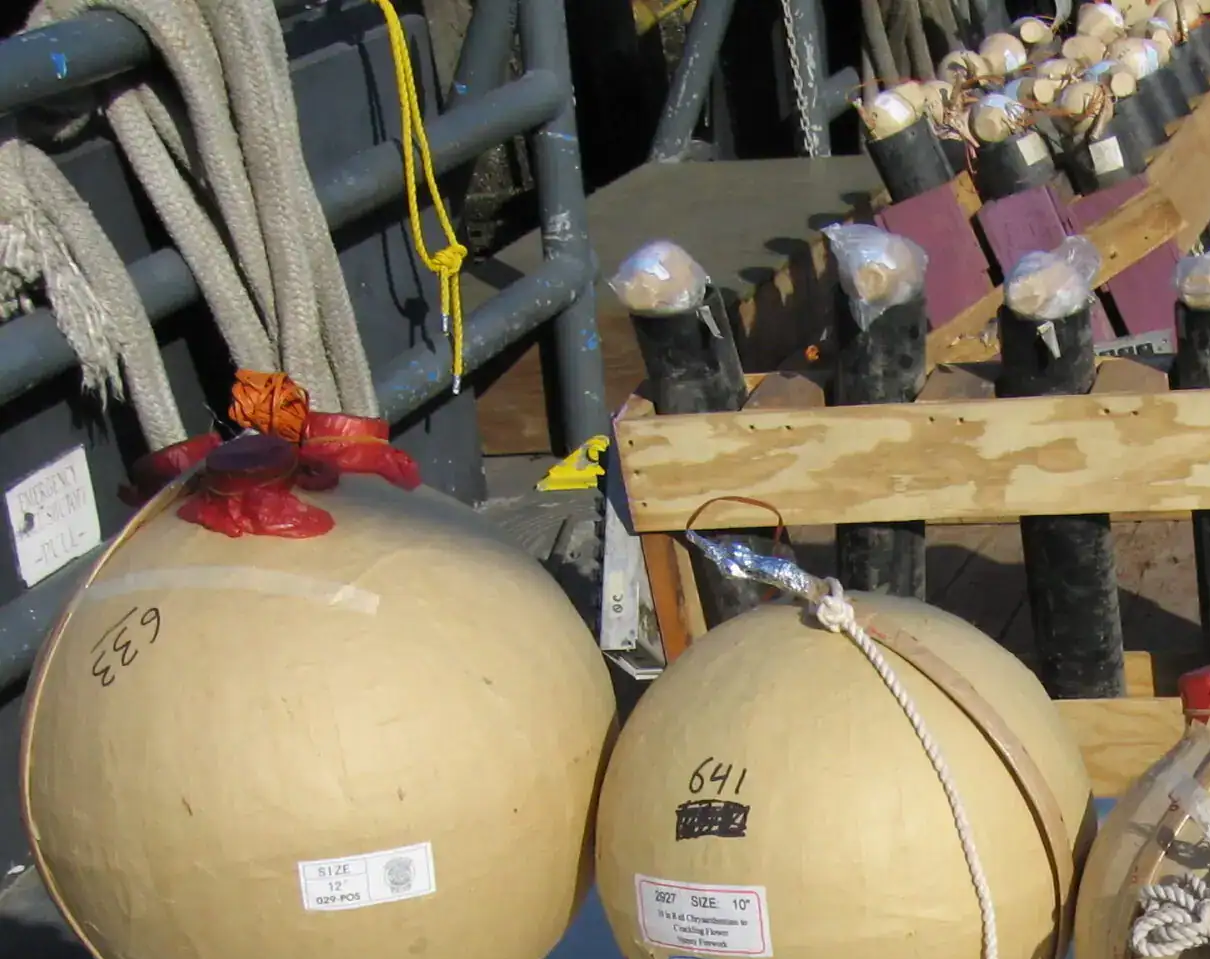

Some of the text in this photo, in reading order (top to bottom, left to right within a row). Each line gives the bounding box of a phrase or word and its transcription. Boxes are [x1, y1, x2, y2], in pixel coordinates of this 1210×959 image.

[92, 607, 160, 687] 633
[689, 756, 747, 795] 641
[318, 863, 351, 877] SIZE
[316, 892, 361, 905] 029-POS
[733, 899, 750, 911] 10"
